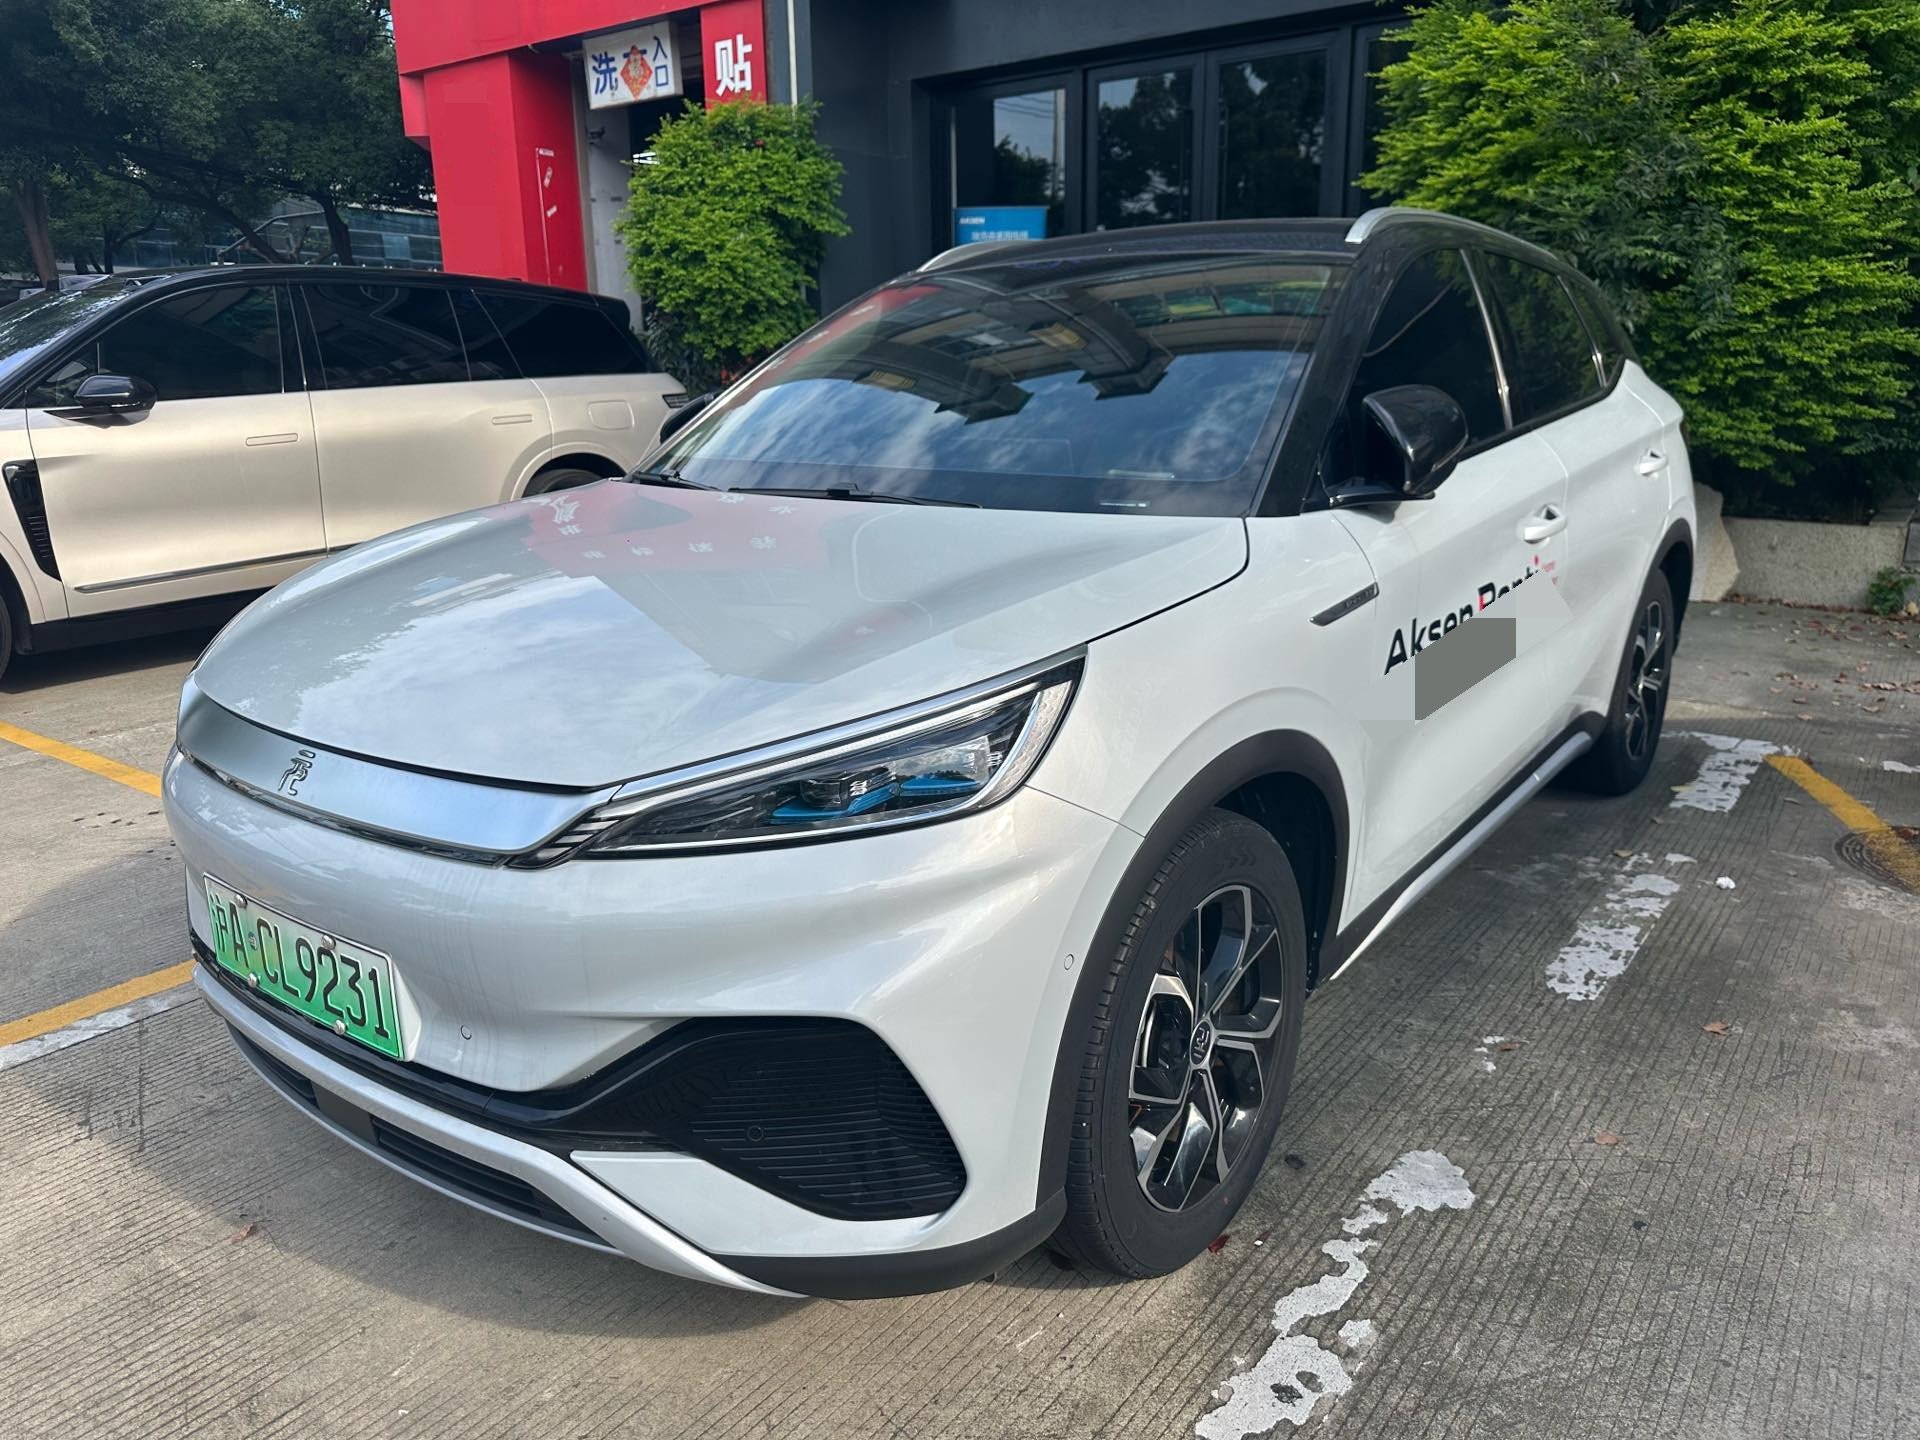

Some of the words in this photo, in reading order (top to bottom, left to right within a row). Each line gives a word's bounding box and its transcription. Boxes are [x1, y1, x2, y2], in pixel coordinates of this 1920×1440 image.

[592, 45, 648, 95] 洗
[652, 36, 669, 87] 入口
[715, 34, 752, 96] 贴
